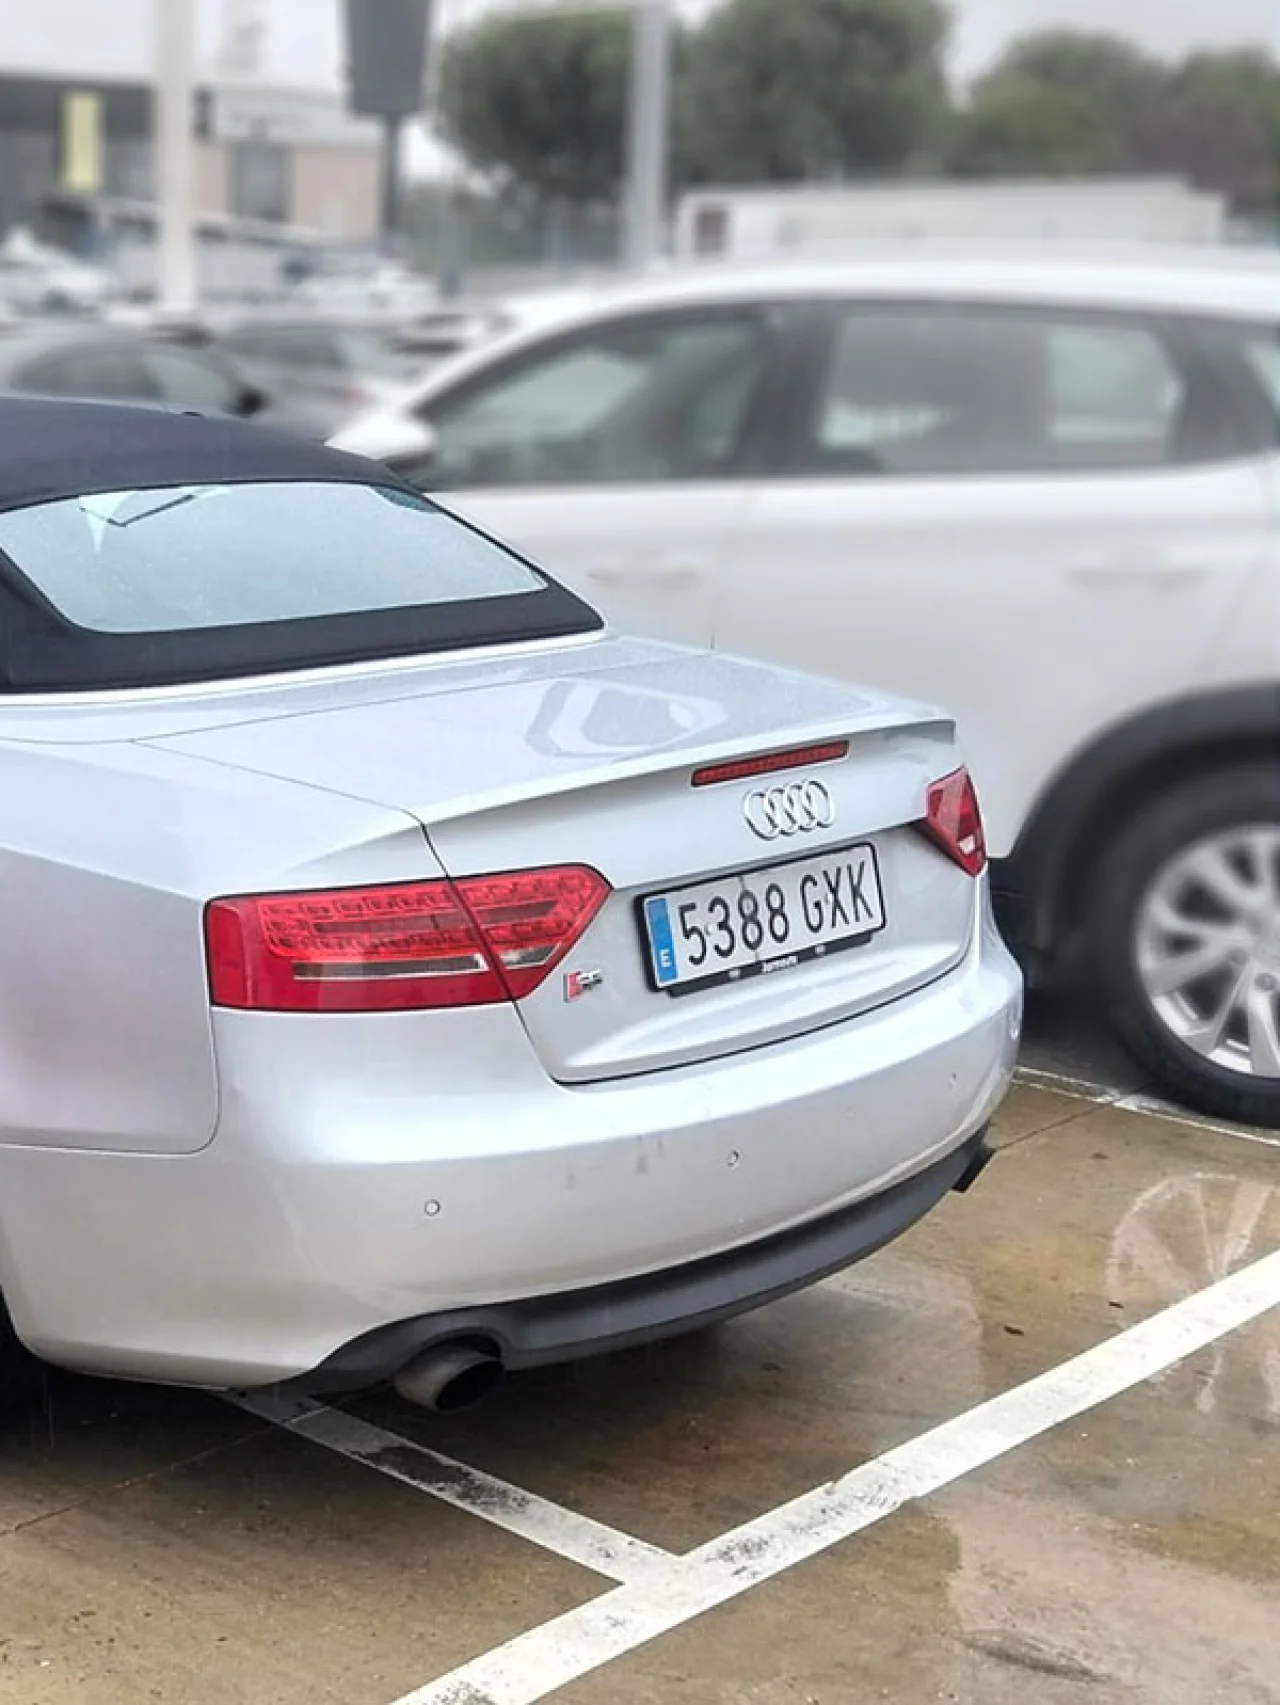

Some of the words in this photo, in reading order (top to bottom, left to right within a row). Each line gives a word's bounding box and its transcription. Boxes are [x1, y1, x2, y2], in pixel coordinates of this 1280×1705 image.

[678, 882, 789, 965] 5388
[800, 860, 873, 933] GXK
[660, 948, 673, 968] E
